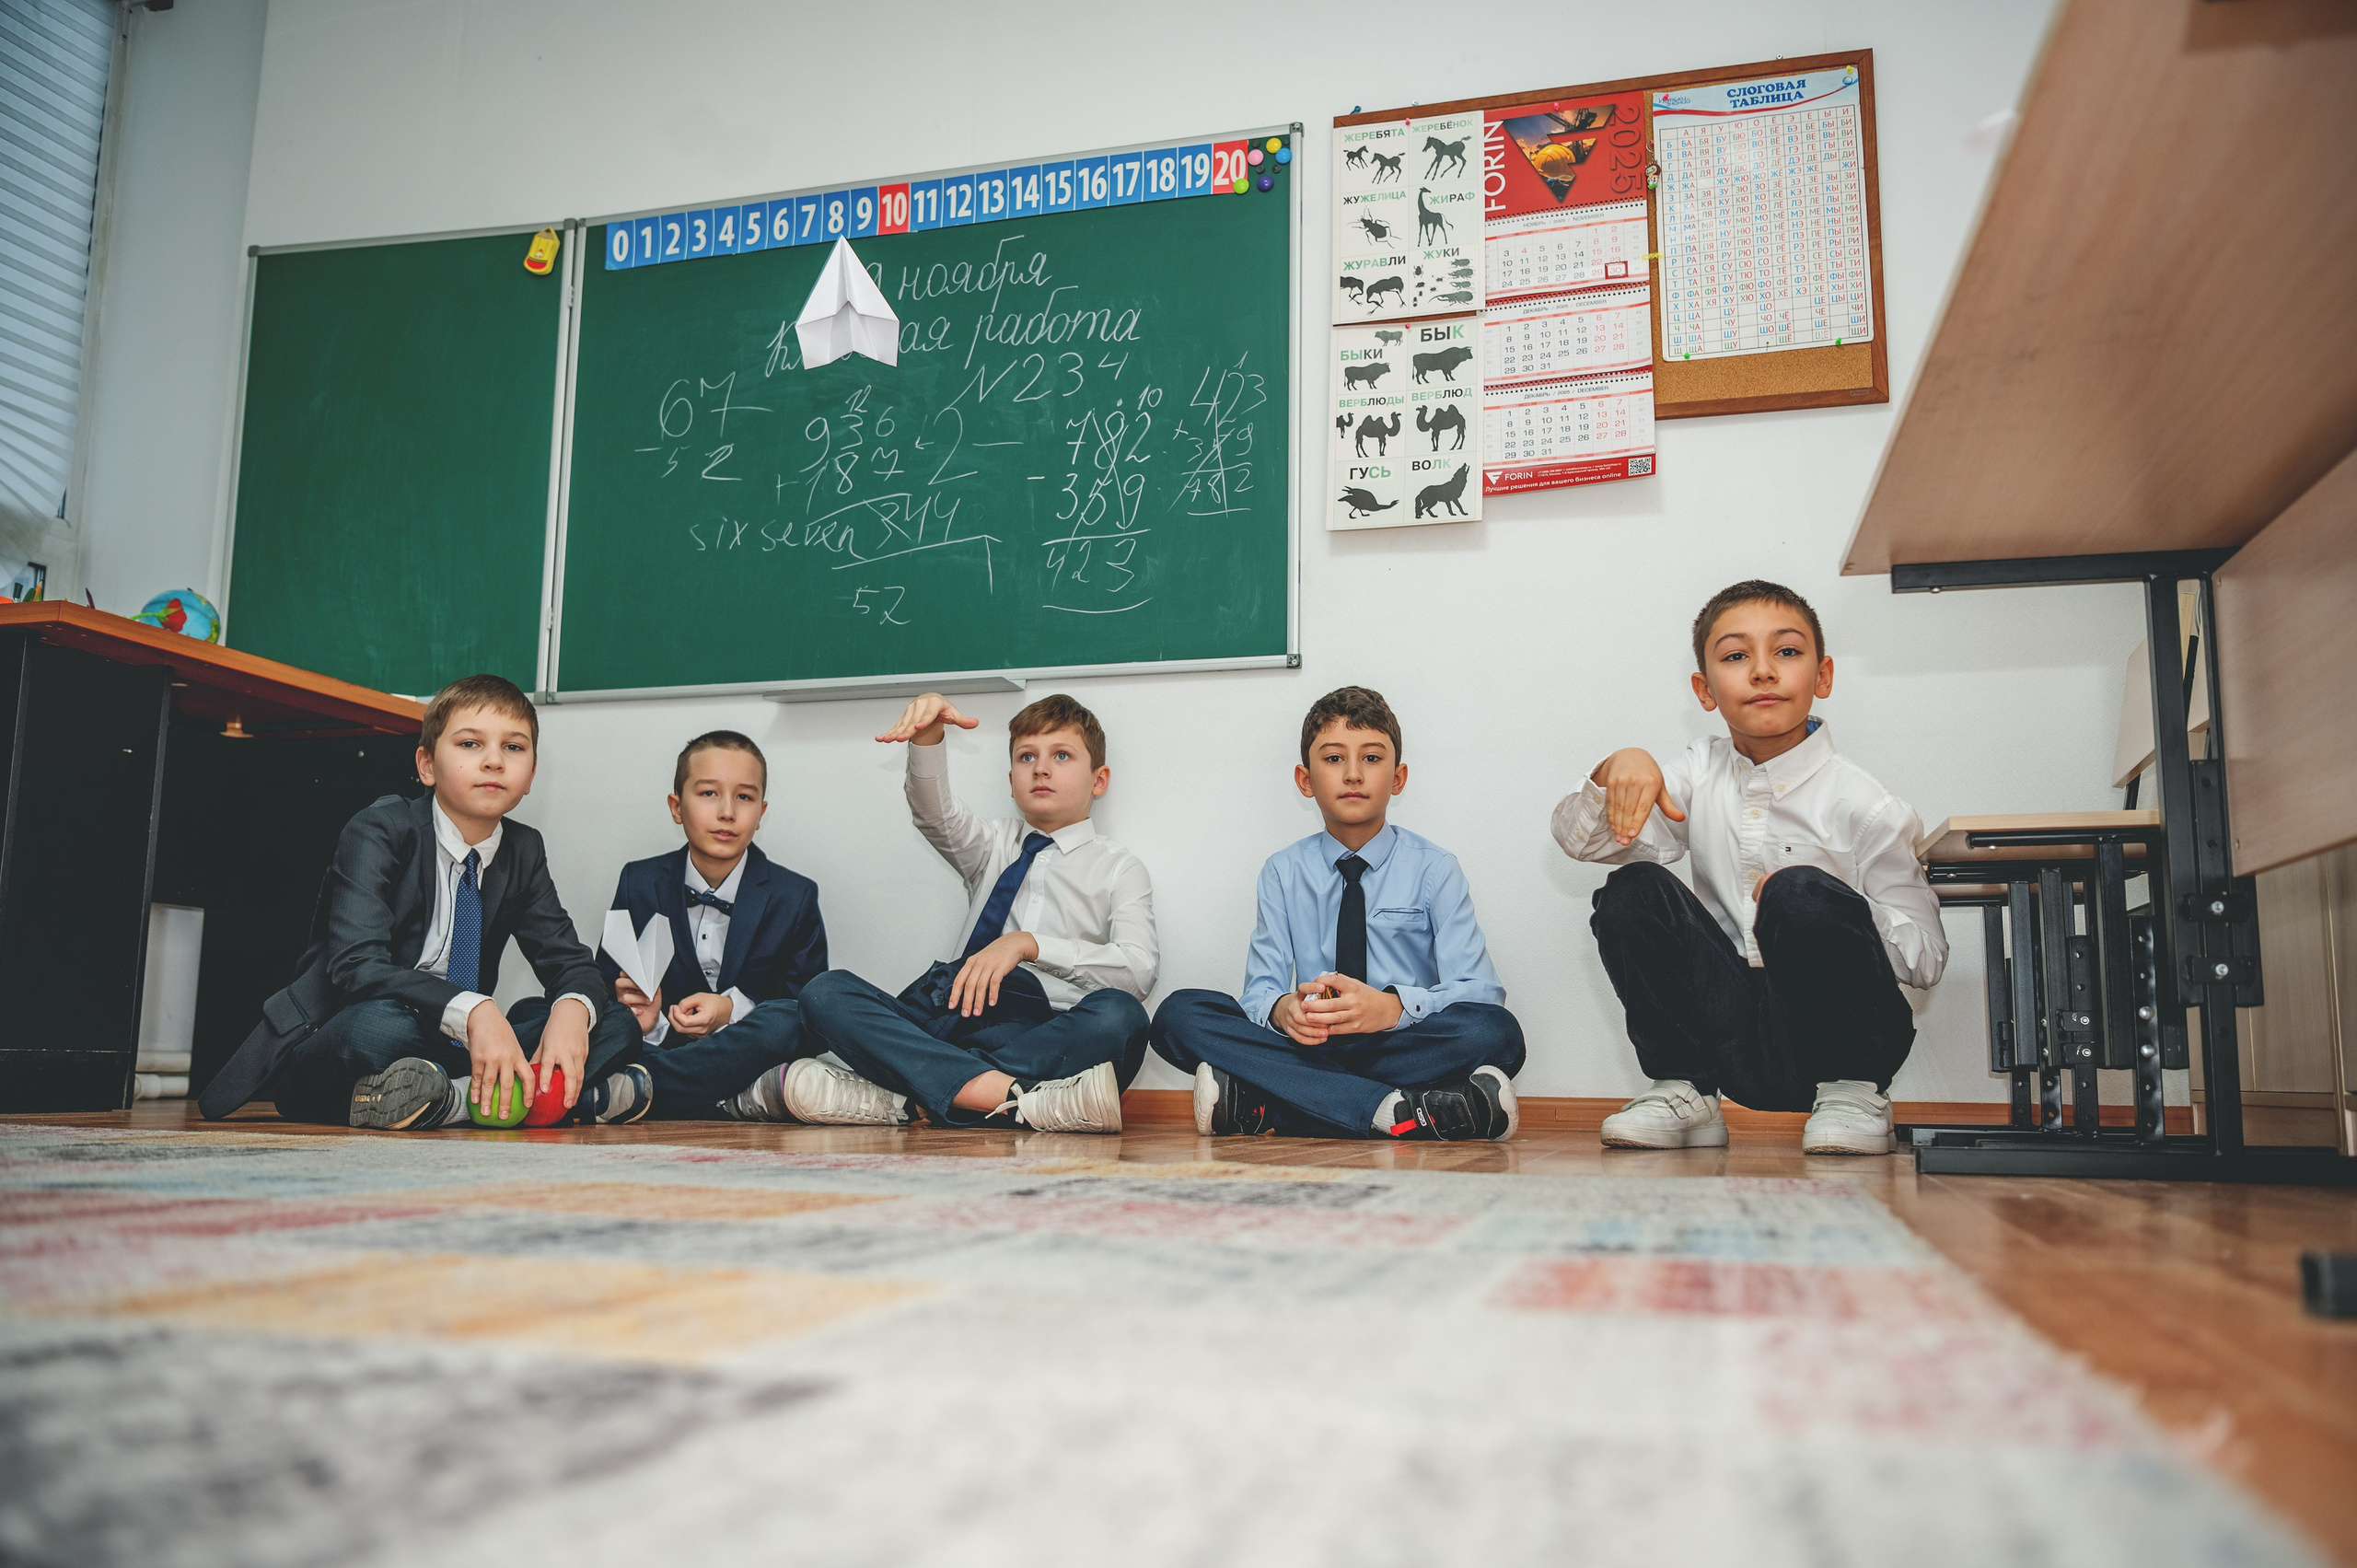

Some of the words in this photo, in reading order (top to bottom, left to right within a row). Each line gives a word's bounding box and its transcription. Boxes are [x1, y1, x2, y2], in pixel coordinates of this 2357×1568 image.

[1726, 79, 1806, 98] СЛОГОВАЯ
[1730, 90, 1805, 109] ТАБЛИЦА
[1412, 119, 1473, 134] ЖЕРЕБЁНОК
[1343, 128, 1405, 143] ЖЕРЕБЯТА
[1609, 103, 1642, 194] 2025
[1484, 120, 1506, 212] FORIN
[613, 230, 629, 261] 0
[641, 226, 652, 258] 1
[665, 223, 681, 255] 2
[692, 219, 707, 251] 3
[718, 215, 735, 247] 4
[747, 212, 761, 244] 5
[773, 208, 789, 240] 6
[801, 204, 817, 238] 7
[829, 201, 844, 233] 8
[856, 196, 873, 230] 9
[882, 192, 908, 227] 10
[914, 189, 937, 223] 11
[946, 184, 972, 219] 12
[979, 180, 1004, 214] 13
[1012, 175, 1039, 210] 14
[1045, 170, 1072, 205] 15
[1078, 166, 1107, 201] 16
[1113, 162, 1141, 197] 17
[1146, 157, 1176, 193] 18
[1181, 153, 1210, 189] 19
[1213, 149, 1247, 185] 20
[1343, 191, 1407, 204] ЖУЖЕЛИЦА
[1429, 192, 1476, 204] ЖИРАФ
[1573, 213, 1605, 222] NOVEMBER
[1422, 248, 1460, 260] ЖУКИ
[1671, 258, 1677, 266] Р
[1687, 256, 1697, 264] РА
[1704, 253, 1714, 262] РЯ
[1722, 251, 1732, 260] РУ
[1738, 249, 1752, 257] РЮ
[1758, 247, 1769, 255] РО
[1776, 244, 1785, 253] РЁ
[1794, 242, 1805, 250] РЭ
[1813, 240, 1821, 249] РЕ
[1829, 238, 1841, 247] РЫ
[1848, 237, 1859, 245] РИ
[1343, 255, 1406, 271] ЖУРАВЛИ
[1609, 256, 1621, 264] 23
[898, 235, 1053, 313] ноября
[1609, 266, 1621, 274] 30
[1523, 307, 1550, 315] ДЕКАБРЬ
[1575, 299, 1608, 308] DECEMBER
[965, 285, 1142, 369] работа
[1421, 324, 1465, 343] БЫК
[1341, 348, 1383, 361] БЫКИ
[1138, 384, 1163, 411] 10
[1411, 388, 1472, 401] ВЕРБЛЮД
[1524, 391, 1550, 400] ДЕКАБРЬ
[1577, 386, 1609, 394] DECEMBER
[660, 372, 773, 439] 67
[1339, 396, 1404, 408] ВЕРБЛЮДЫ
[1507, 410, 1513, 418] 1
[1411, 458, 1452, 471] ВОЛК
[1350, 466, 1391, 480] ГУСЬ
[1504, 471, 1533, 481] FORIN
[1485, 484, 1509, 493] Лучшие
[1510, 482, 1538, 491] решения
[1574, 474, 1601, 482] бизнеса
[690, 517, 749, 551] six
